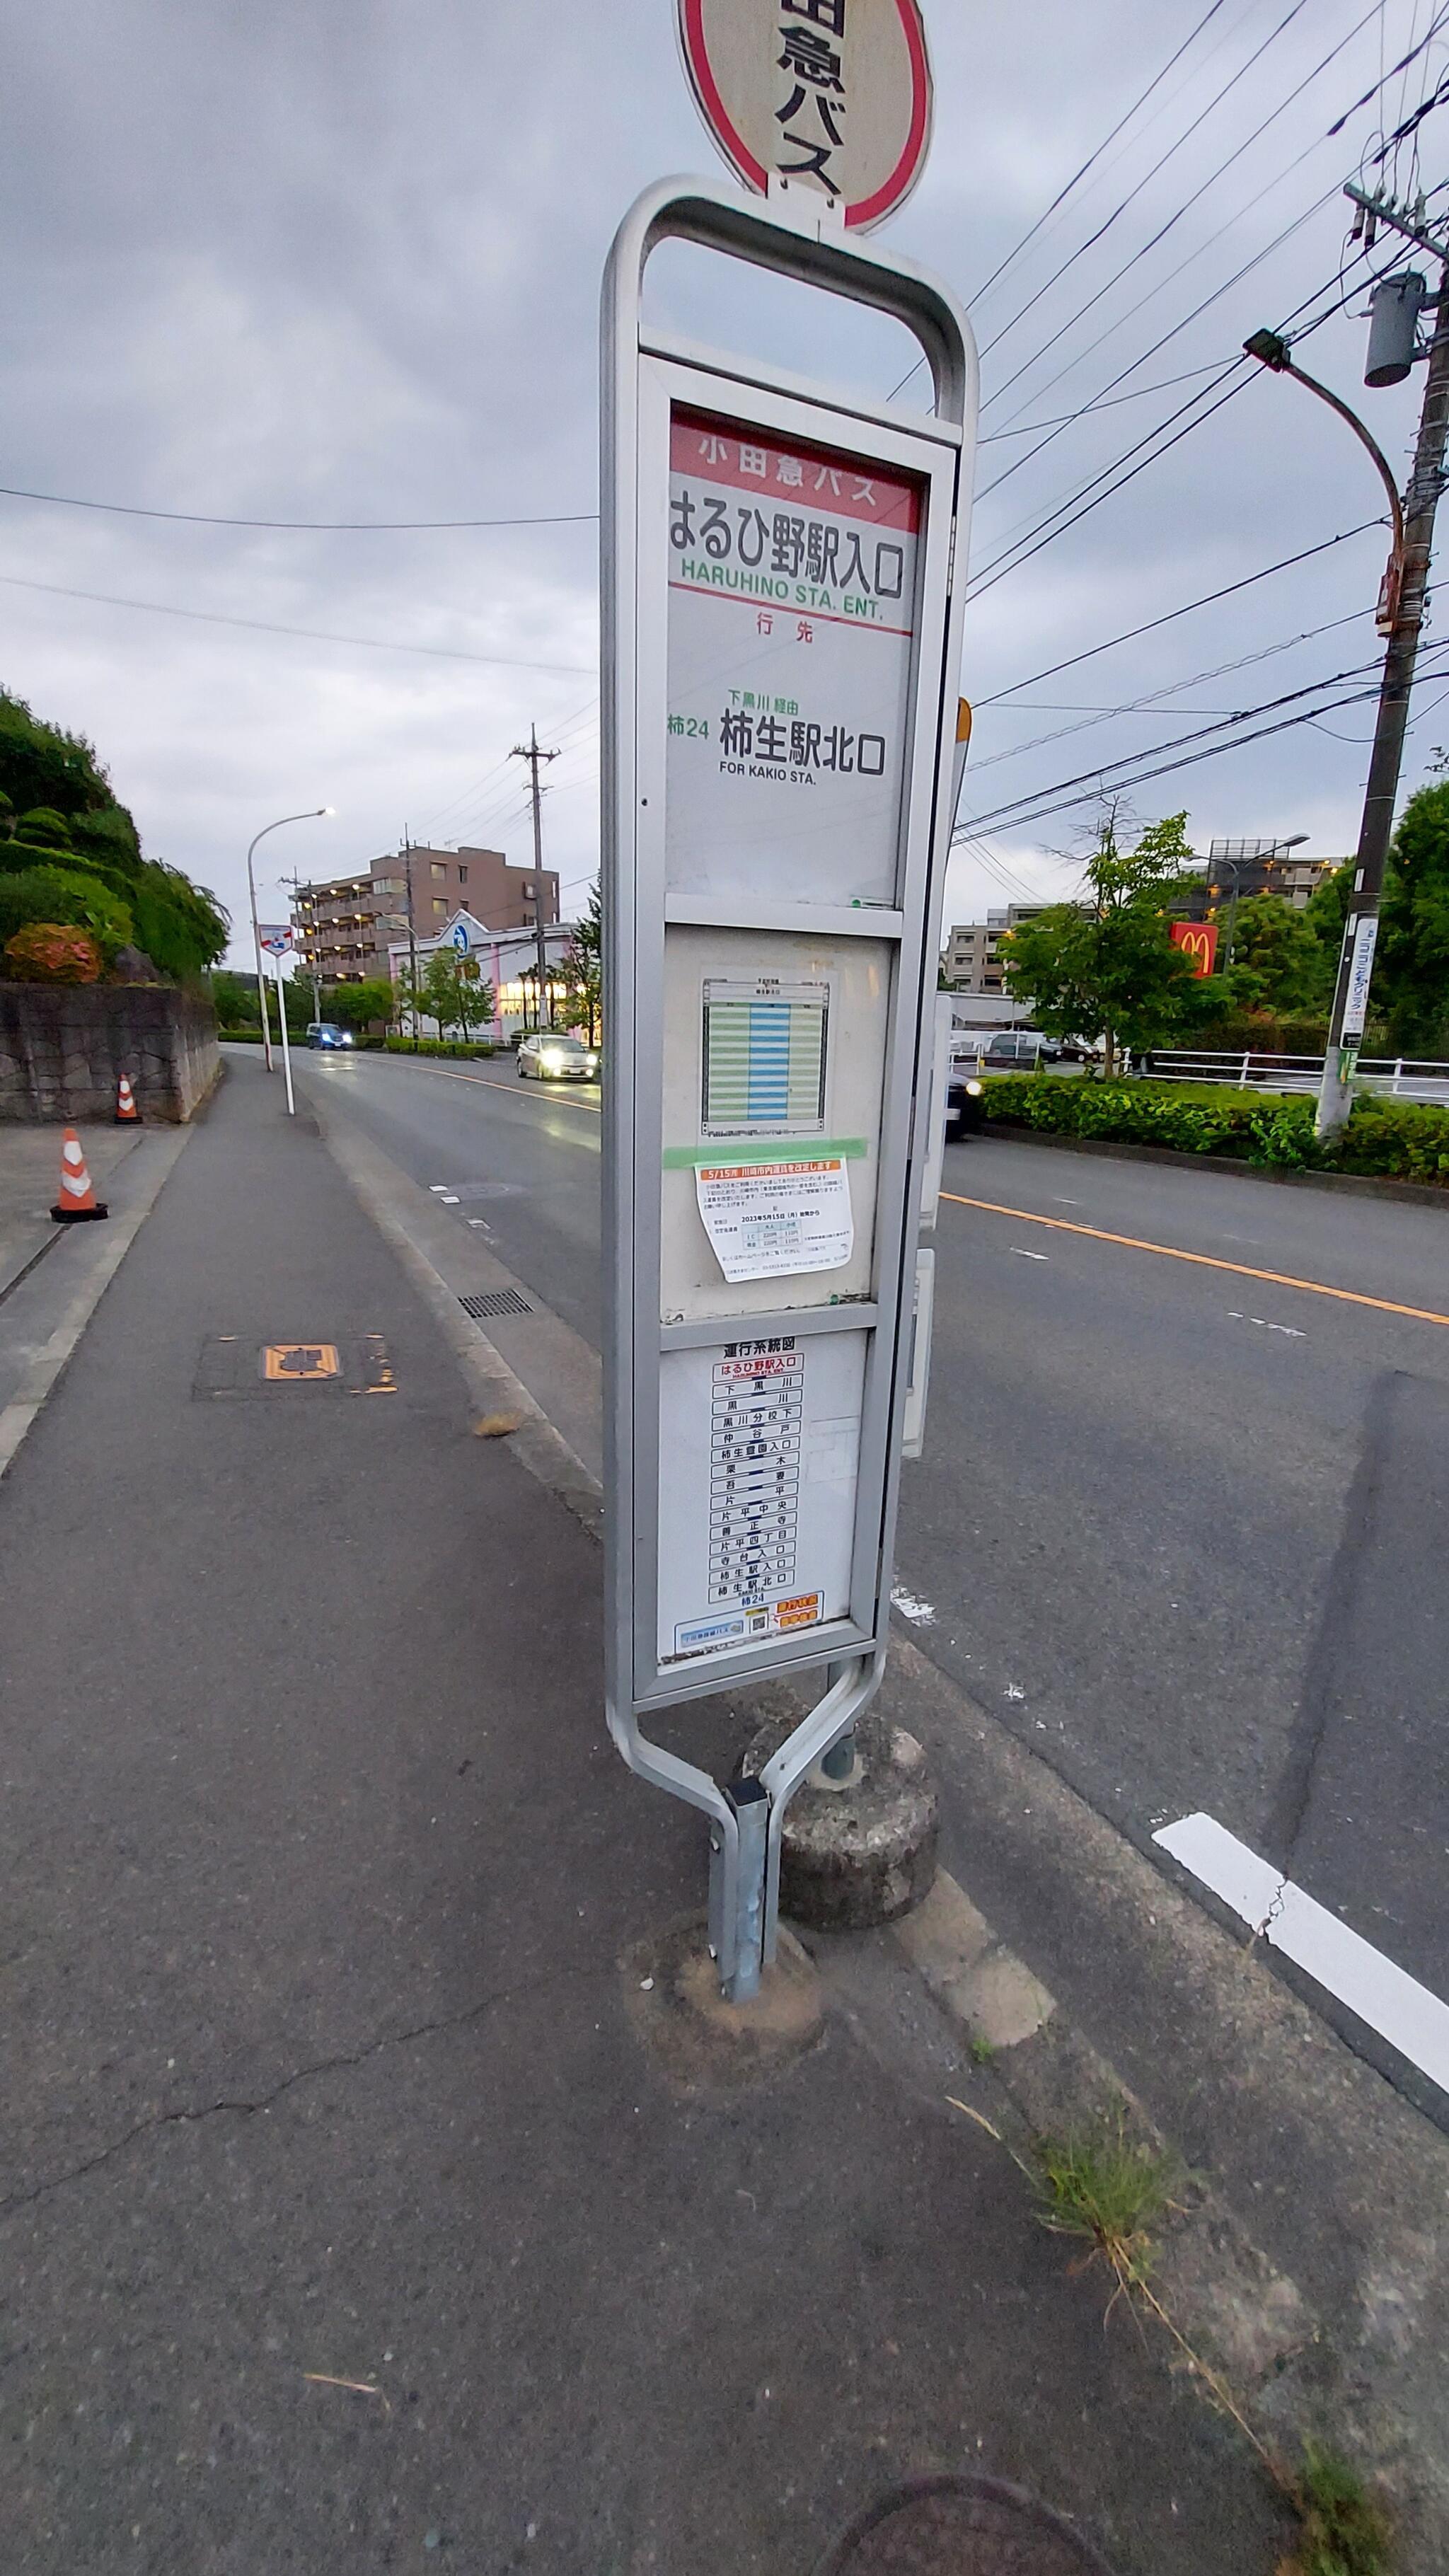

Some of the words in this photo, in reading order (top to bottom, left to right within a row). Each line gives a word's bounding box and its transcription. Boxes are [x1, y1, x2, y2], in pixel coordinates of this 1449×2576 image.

[698, 436, 877, 507] 小田急バス
[670, 490, 904, 599] はるひ野駅入口
[681, 558, 789, 600] HARUHINO
[795, 584, 836, 611] STA.
[843, 595, 884, 620] ENT.
[667, 713, 710, 740] 柿24
[719, 707, 886, 776] 柿生駅北口
[719, 761, 745, 775] FOR
[749, 764, 787, 781] KAKIO
[790, 770, 817, 785] STA.
[723, 1336, 795, 1358] 運行系統図
[721, 1356, 797, 1376] はるひ野駅入口
[724, 1376, 792, 1395] 下黒川
[727, 1392, 788, 1411] 黒川
[723, 1408, 792, 1428] 黒川分校下
[724, 1424, 790, 1444] 仲谷戸
[721, 1439, 791, 1460] 柿生霊園入口
[725, 1486, 785, 1506] 片平
[722, 1501, 787, 1521] 片平中央
[721, 1530, 787, 1551] 片平四丁目
[720, 1559, 785, 1581] 柿生駅入口
[717, 1573, 786, 1596] 柿生駅北口
[741, 1593, 764, 1607] 柿24
